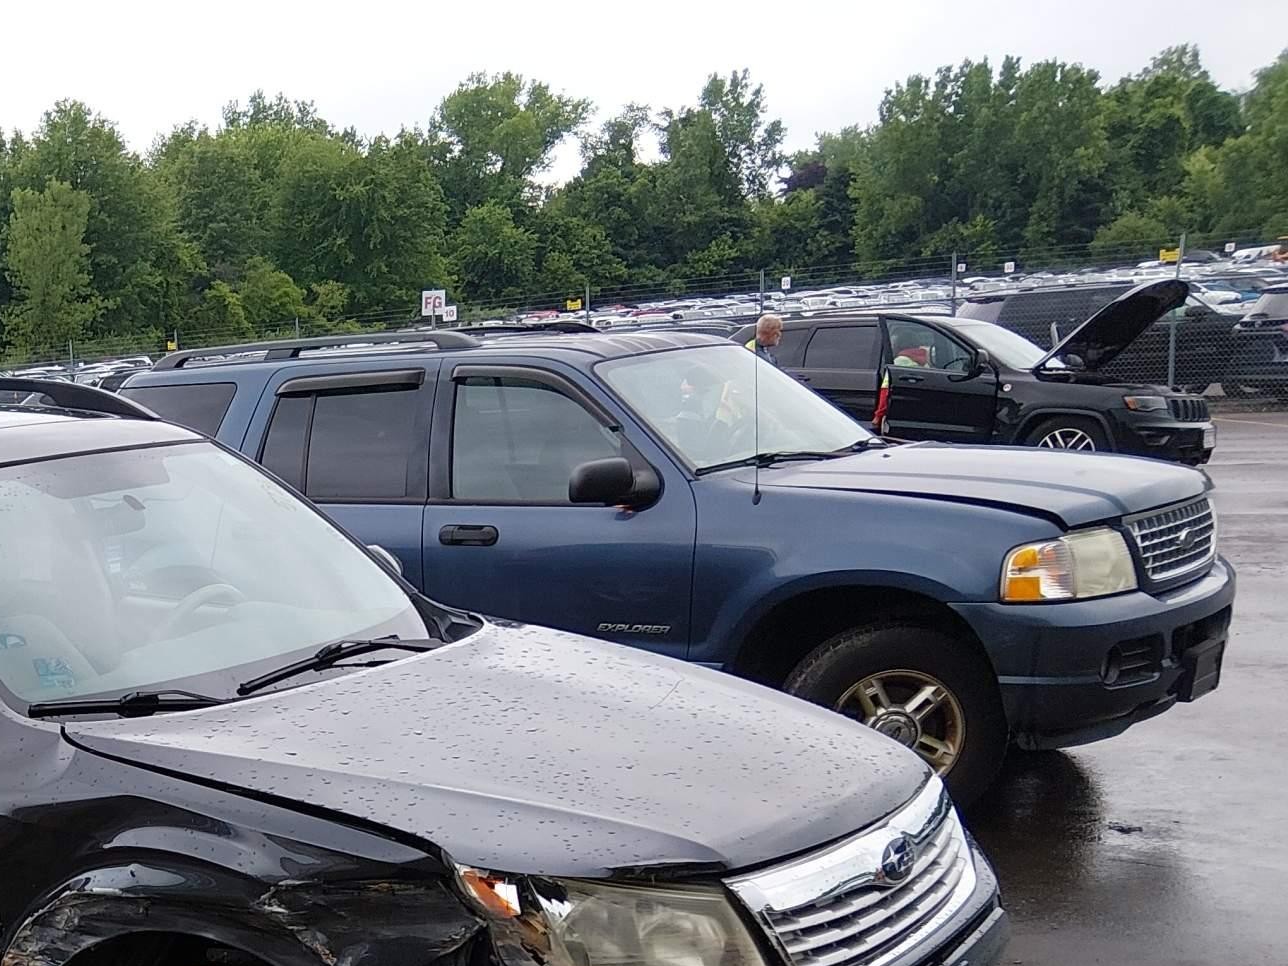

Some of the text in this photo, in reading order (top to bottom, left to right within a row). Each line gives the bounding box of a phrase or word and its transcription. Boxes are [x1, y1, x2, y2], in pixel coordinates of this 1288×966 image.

[424, 295, 442, 309] FG
[445, 309, 455, 318] 10
[597, 623, 671, 634] EXPLORER
